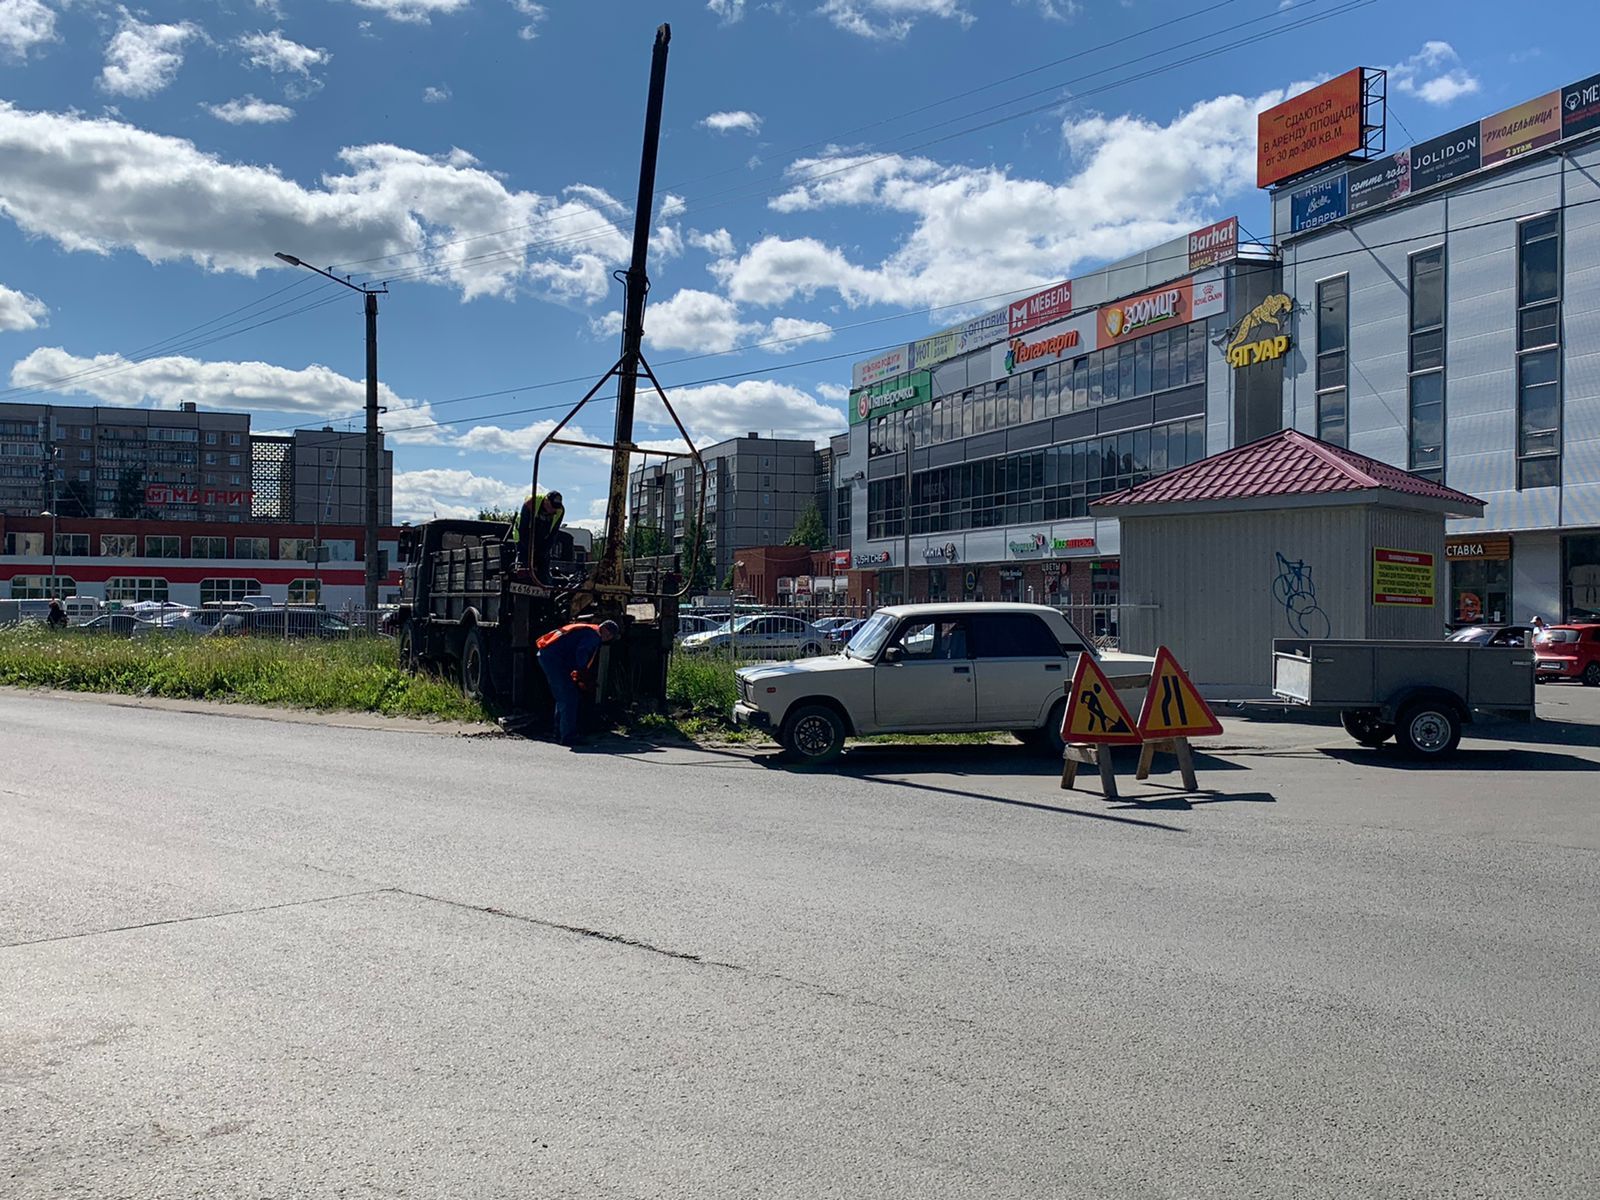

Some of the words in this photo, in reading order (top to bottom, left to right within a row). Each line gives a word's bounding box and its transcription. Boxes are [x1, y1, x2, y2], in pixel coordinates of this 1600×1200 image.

[1263, 142, 1270, 153] В
[1271, 125, 1308, 148] АРЕНДУ
[1309, 103, 1359, 132] ПЛОЩАДИ
[1285, 99, 1332, 129] СДАЮТСЯ
[1265, 156, 1276, 167] от
[1277, 149, 1287, 163] 30
[1288, 147, 1299, 160] до
[1301, 137, 1317, 153] 300
[1413, 136, 1476, 170] JOLIDON
[1505, 148, 1512, 158] 2
[1300, 210, 1337, 229] ТОВАРЫ
[1190, 221, 1234, 253] Barhat
[1213, 251, 1219, 261] 2
[1030, 286, 1070, 315] МЕБЕЛЬ
[1232, 336, 1289, 368] ЯГУАР
